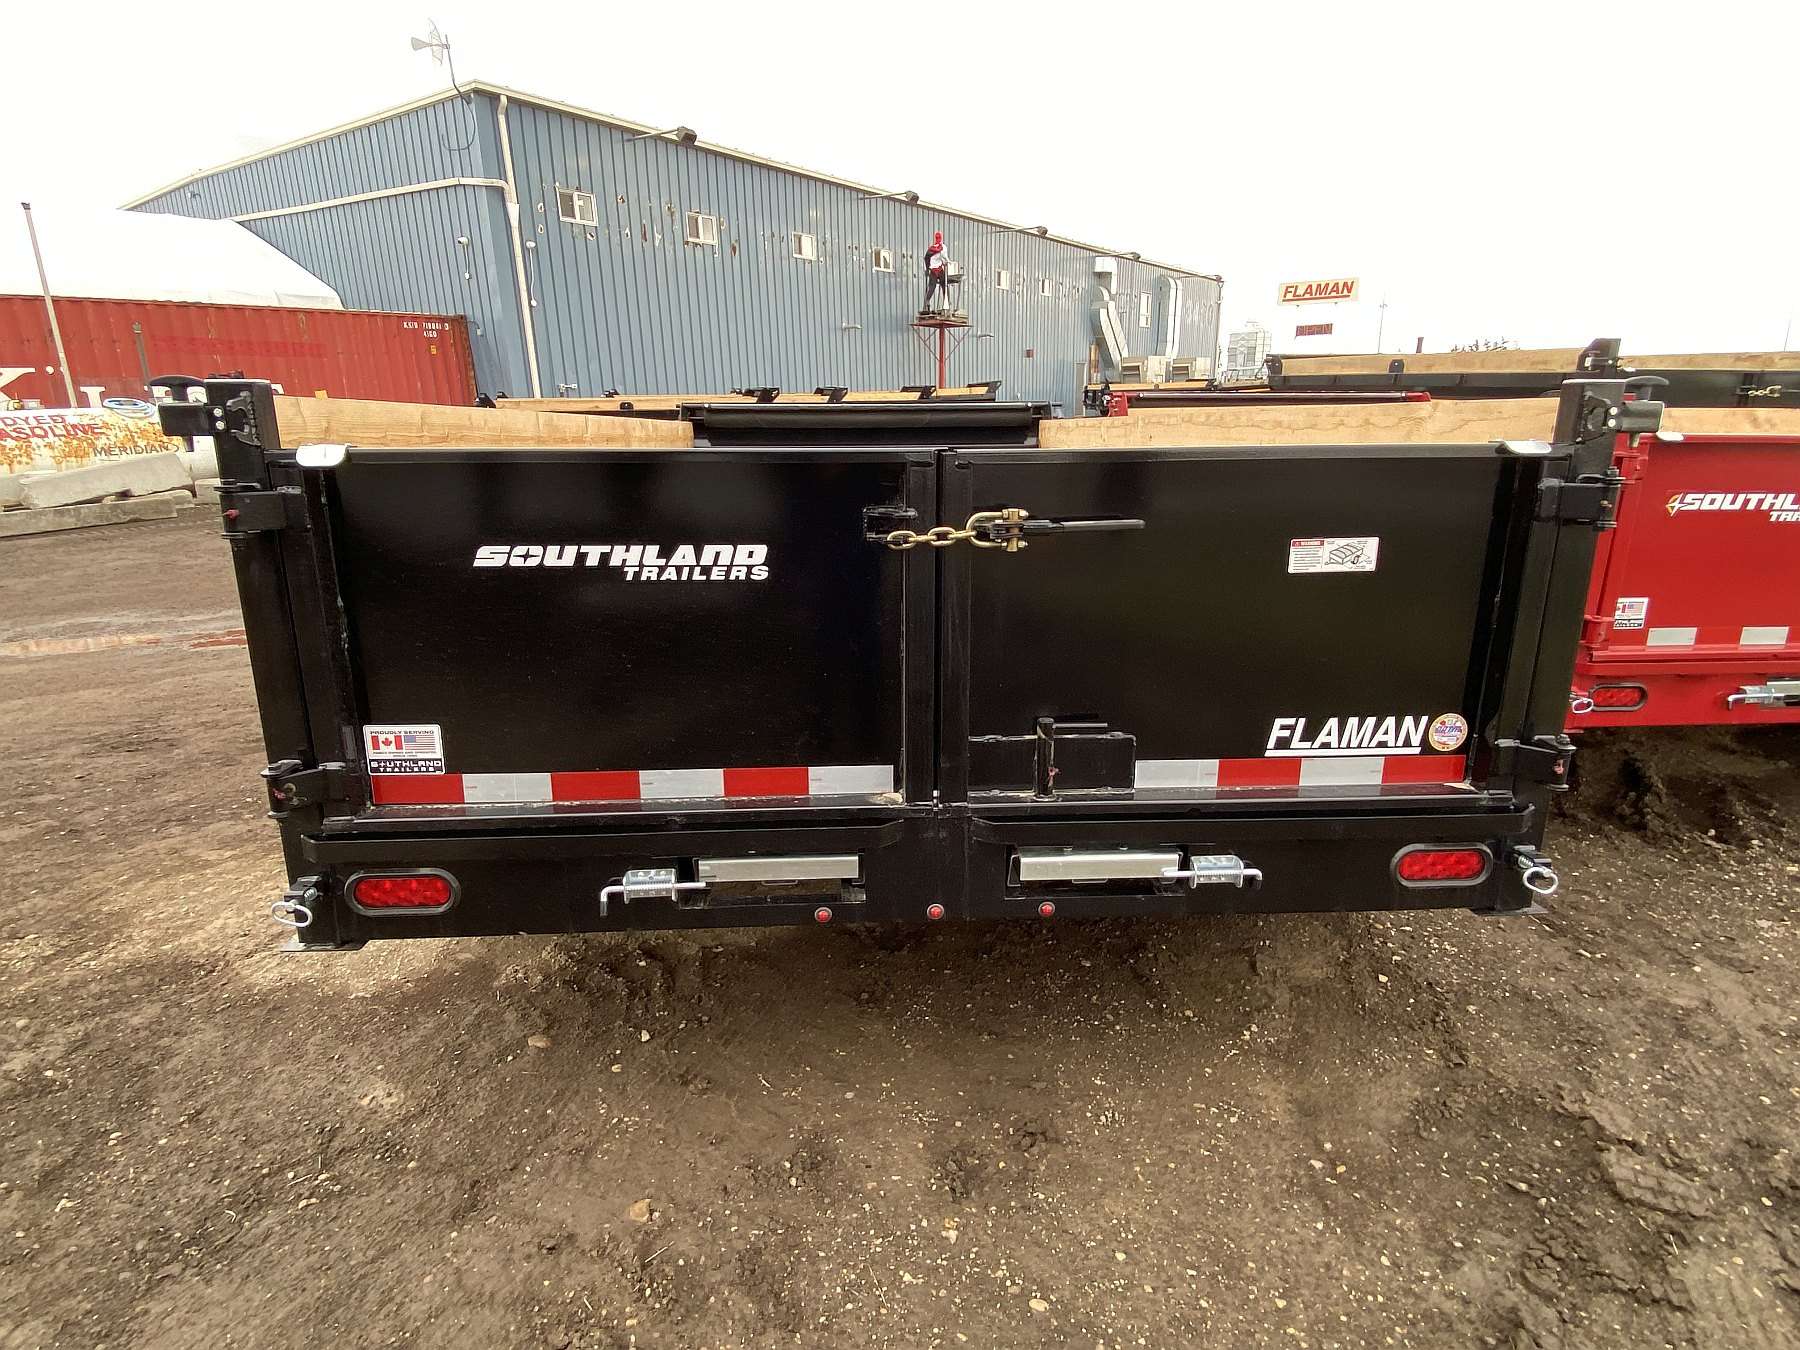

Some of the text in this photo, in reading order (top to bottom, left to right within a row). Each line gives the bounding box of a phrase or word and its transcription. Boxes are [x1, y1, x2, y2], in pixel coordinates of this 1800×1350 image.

[1282, 280, 1355, 299] FLAMAN
[0, 414, 67, 427] DYED
[93, 443, 169, 457] MERIDIAN
[1678, 493, 1800, 511] SOUTHL
[473, 545, 768, 567] SOUTHLAND
[624, 566, 770, 582] TRAILERS
[1266, 715, 1429, 750] FLAMAN
